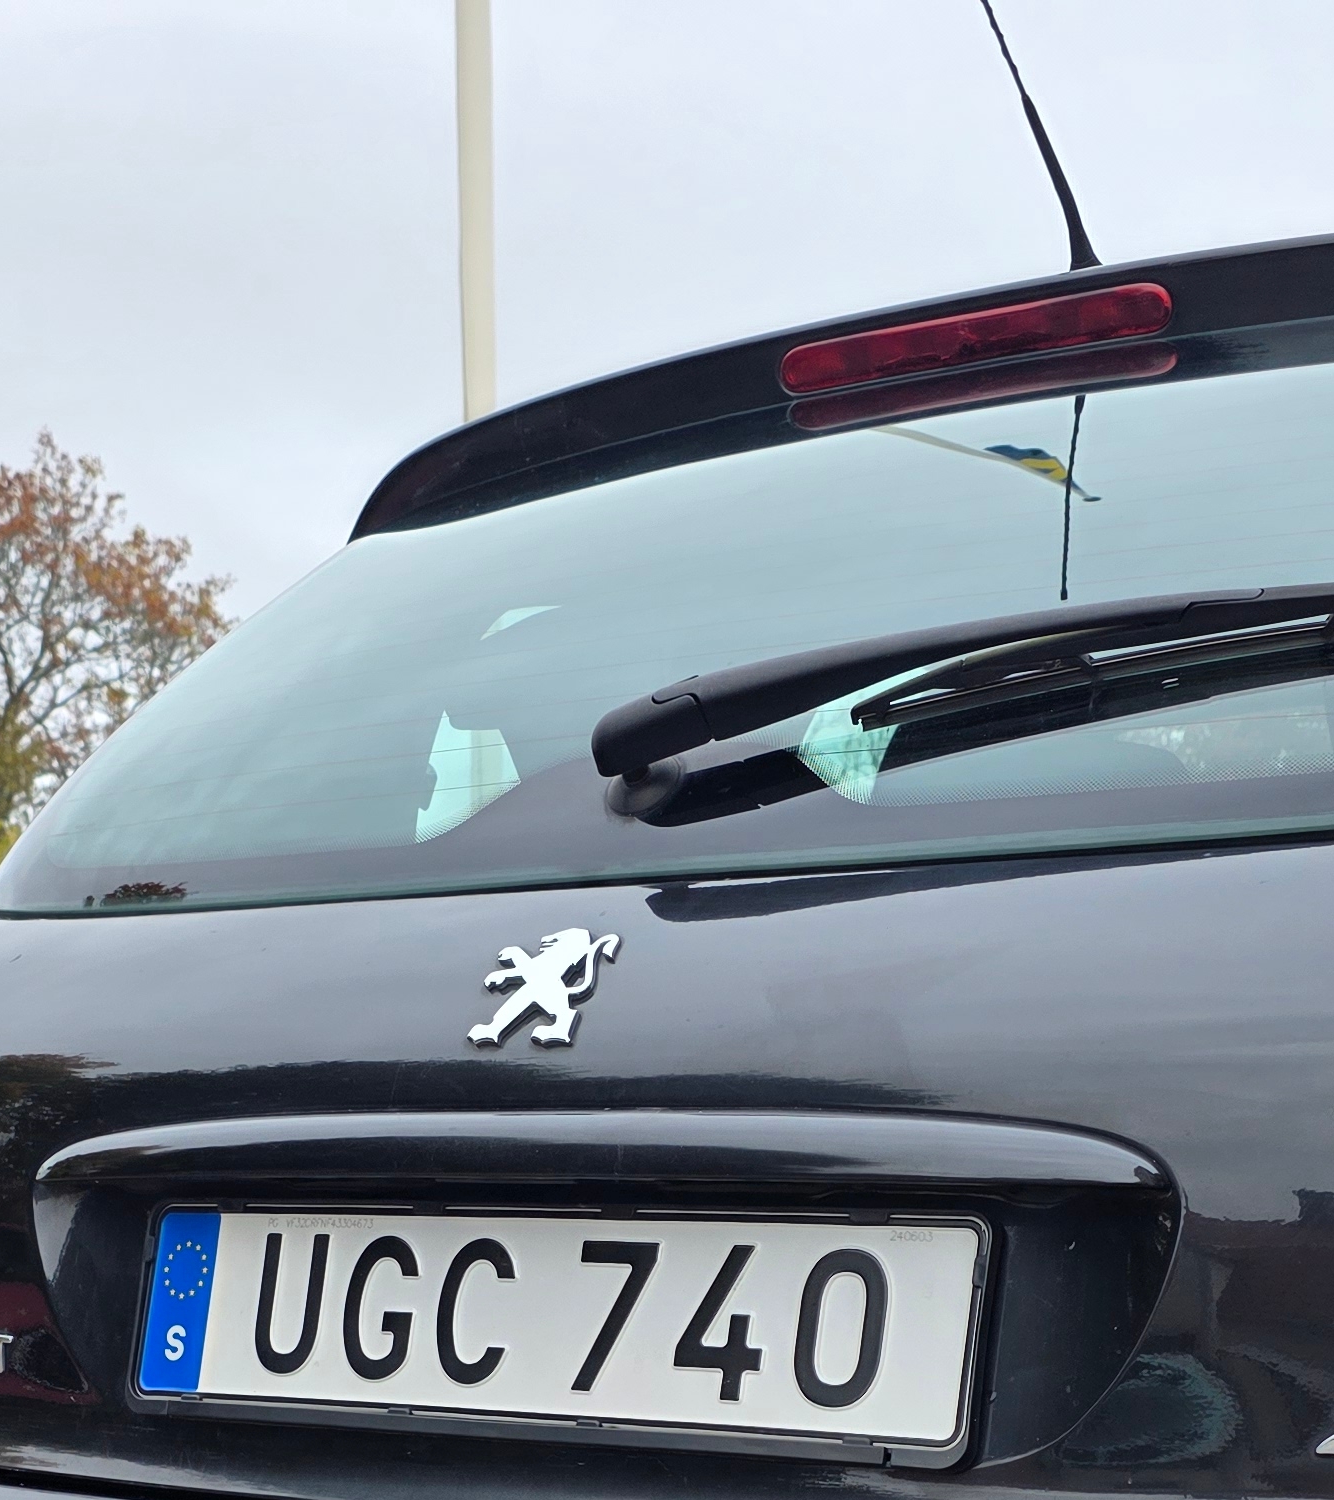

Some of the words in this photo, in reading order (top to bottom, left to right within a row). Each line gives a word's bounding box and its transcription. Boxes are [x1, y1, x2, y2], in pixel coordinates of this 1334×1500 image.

[164, 1324, 187, 1361] S
[254, 1232, 517, 1386] UGC
[570, 1240, 889, 1407] 740
